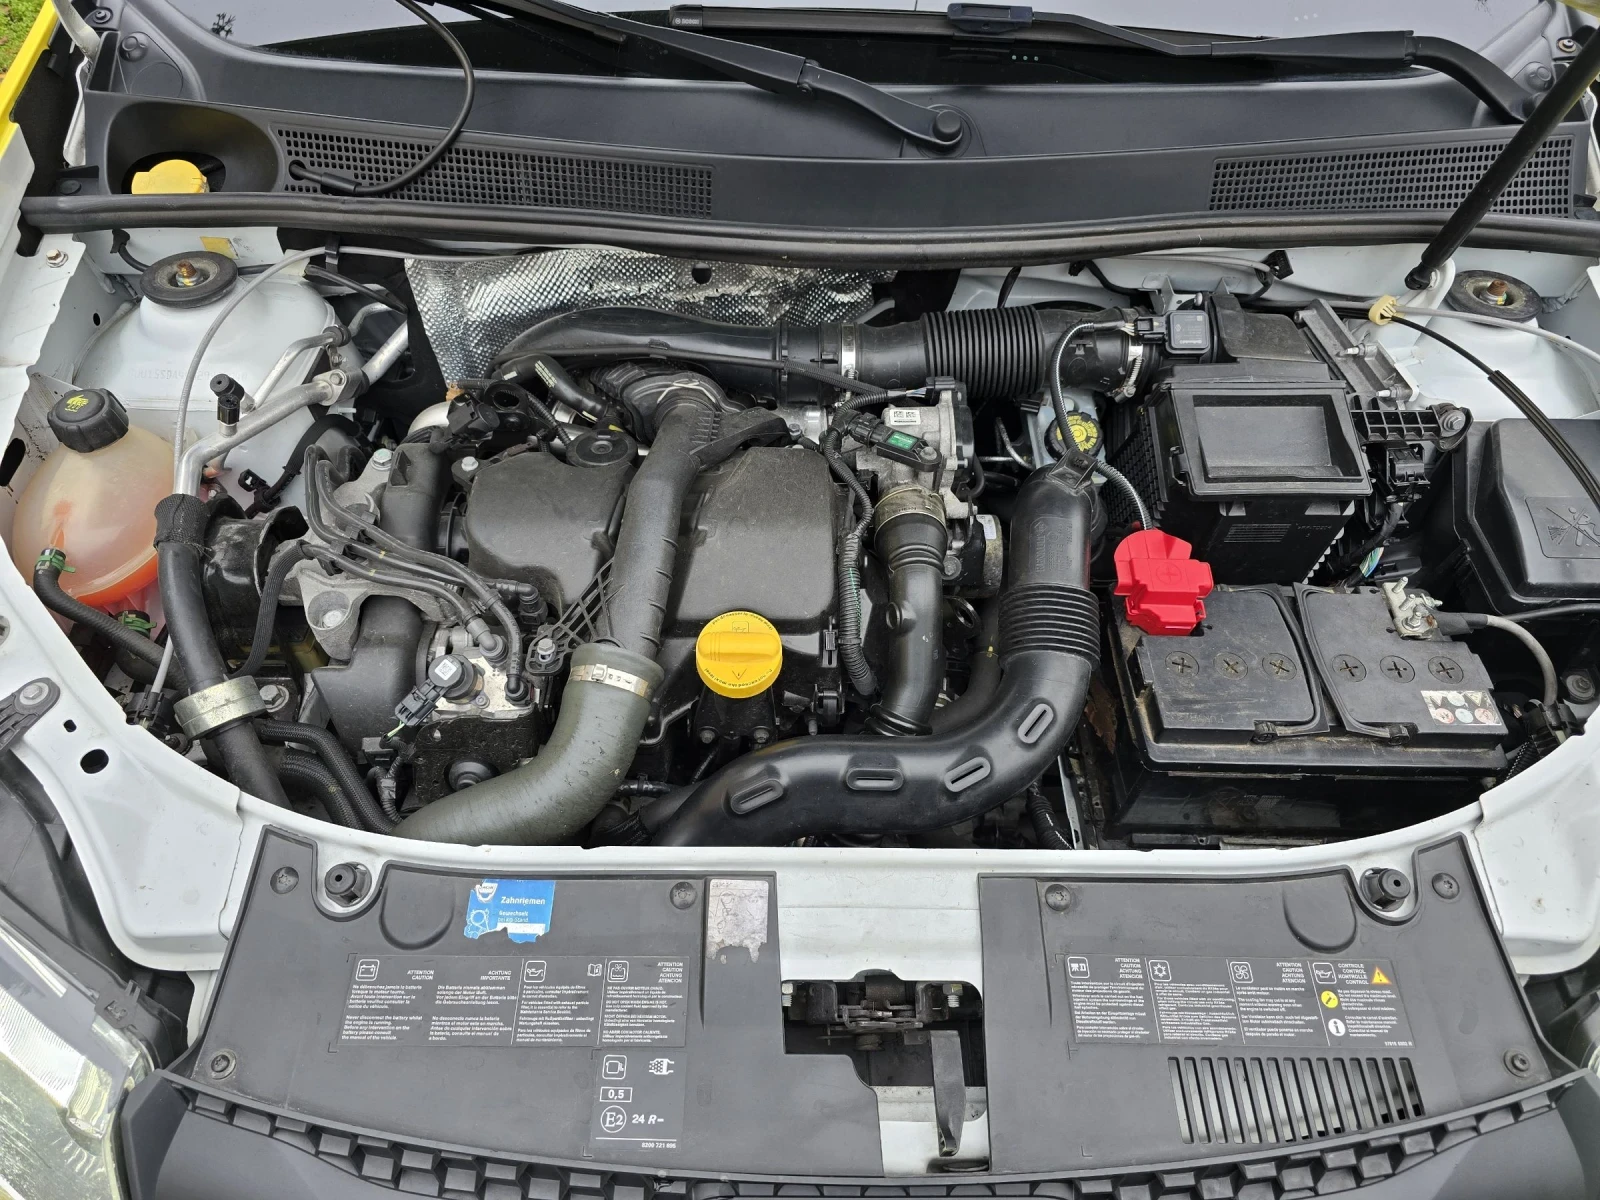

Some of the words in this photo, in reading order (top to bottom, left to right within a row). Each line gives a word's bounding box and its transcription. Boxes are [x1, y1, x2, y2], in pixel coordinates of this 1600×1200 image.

[501, 896, 546, 905] Zahnriemen
[608, 1089, 624, 1100] 0,5
[605, 1112, 623, 1127] E2
[632, 1114, 645, 1124] 24
